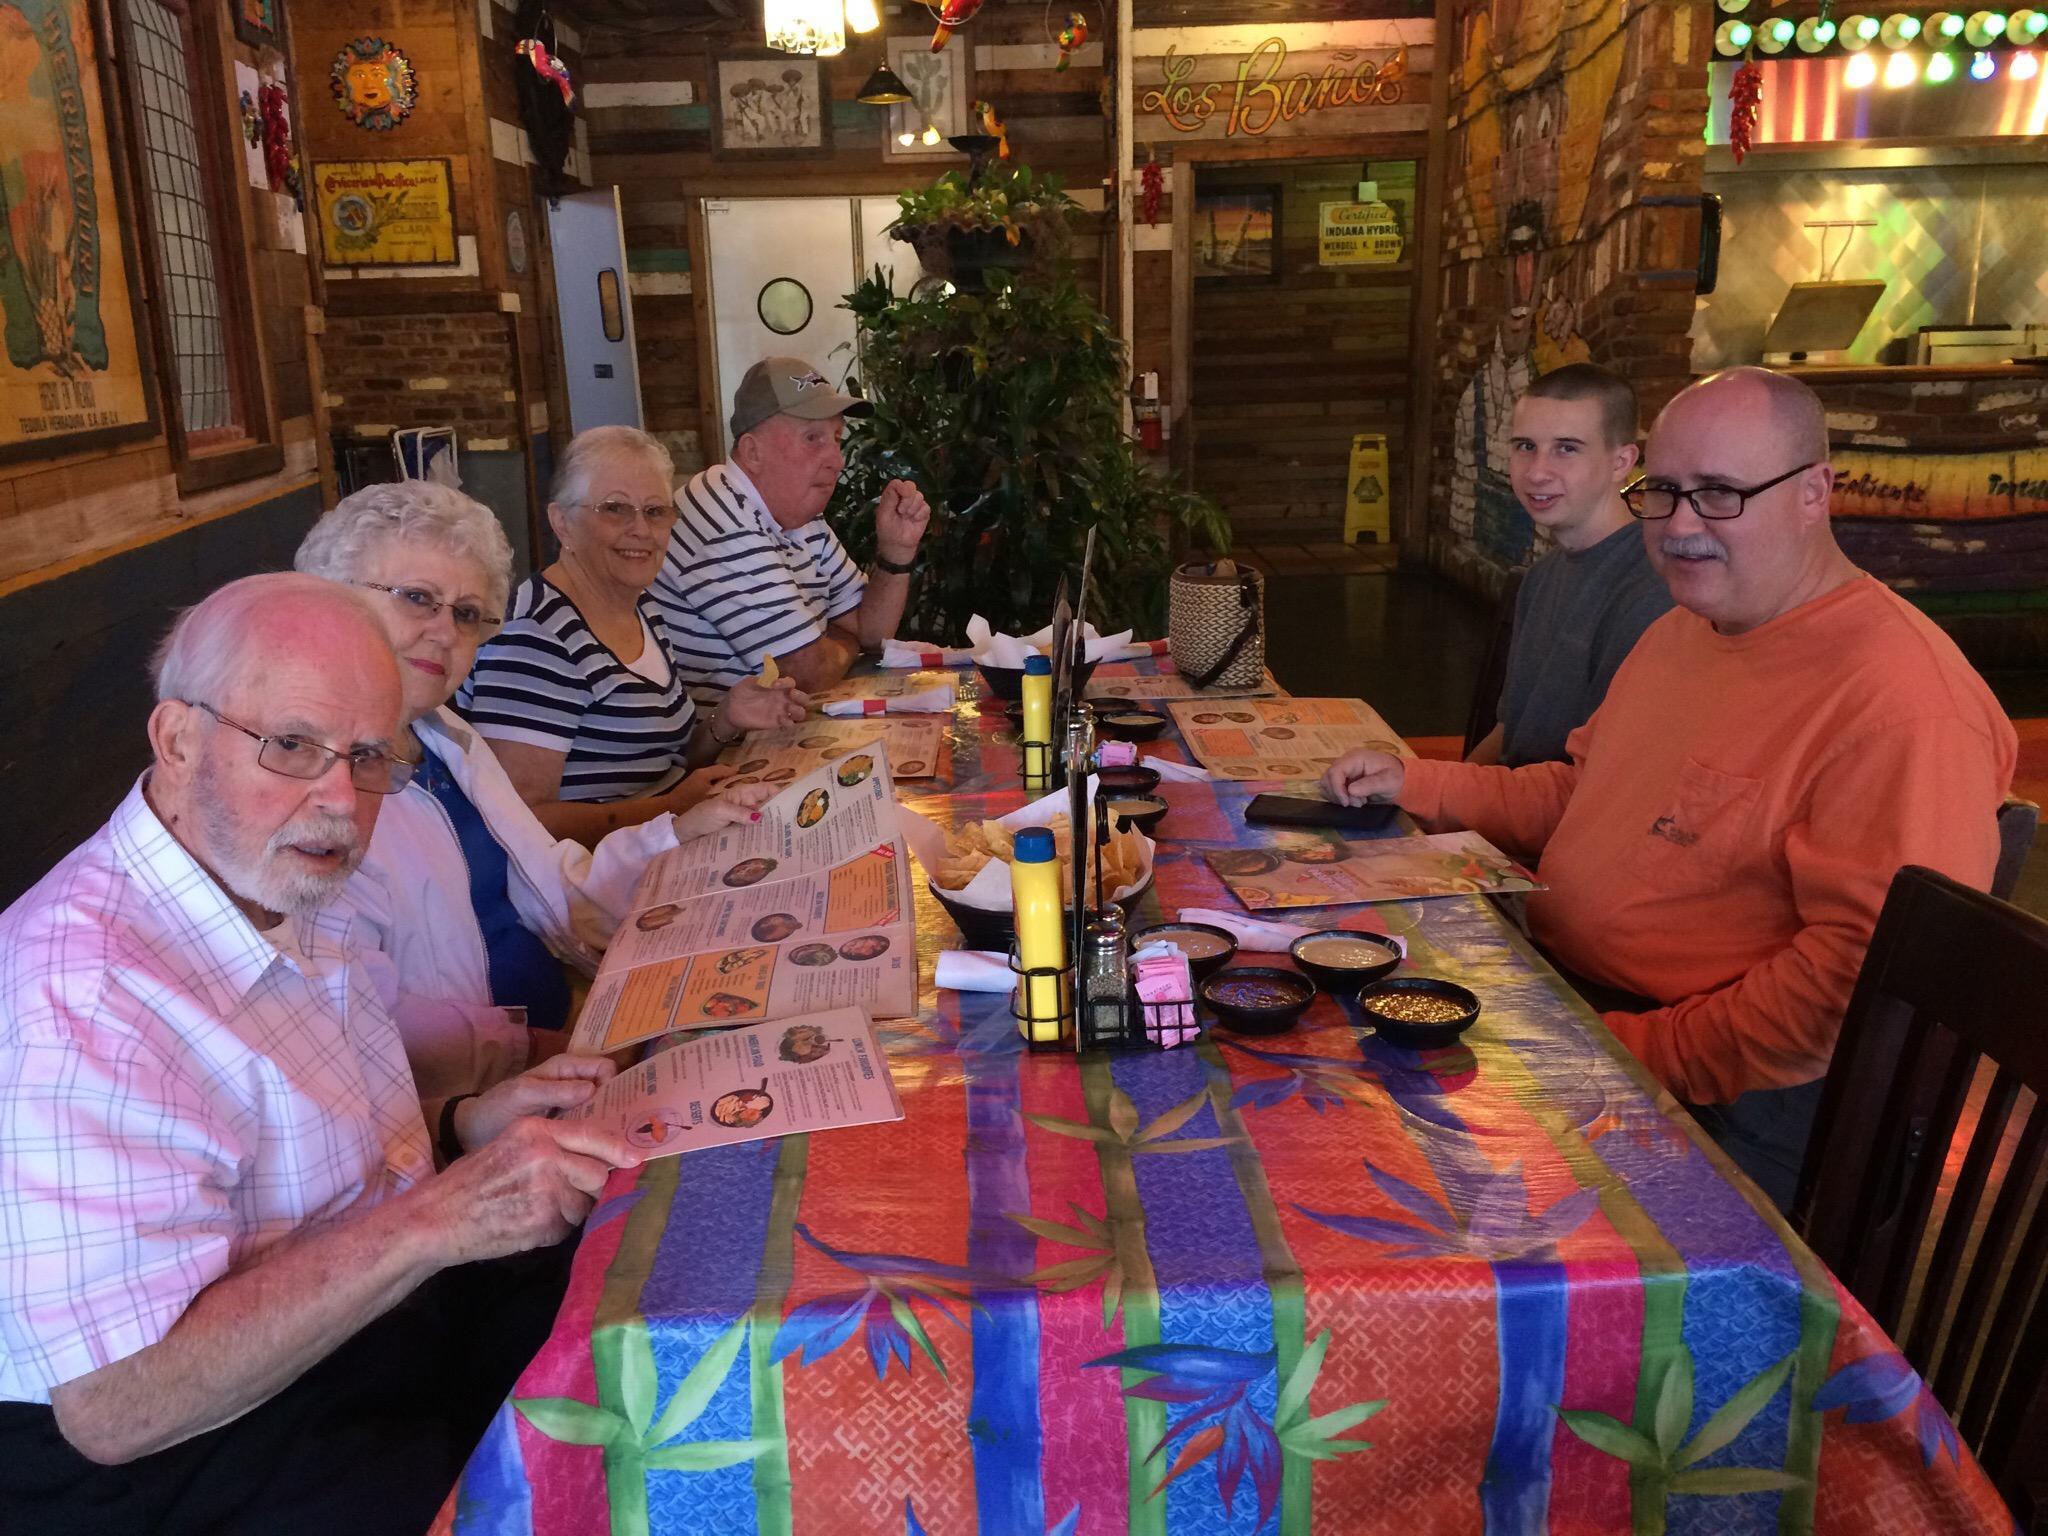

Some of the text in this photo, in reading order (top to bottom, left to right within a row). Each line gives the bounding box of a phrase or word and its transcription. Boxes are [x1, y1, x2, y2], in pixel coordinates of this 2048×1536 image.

[1142, 36, 1401, 138] Los Baños
[1338, 206, 1388, 223] Certified
[393, 224, 433, 235] CLARA
[1325, 226, 1365, 237] INDIANA
